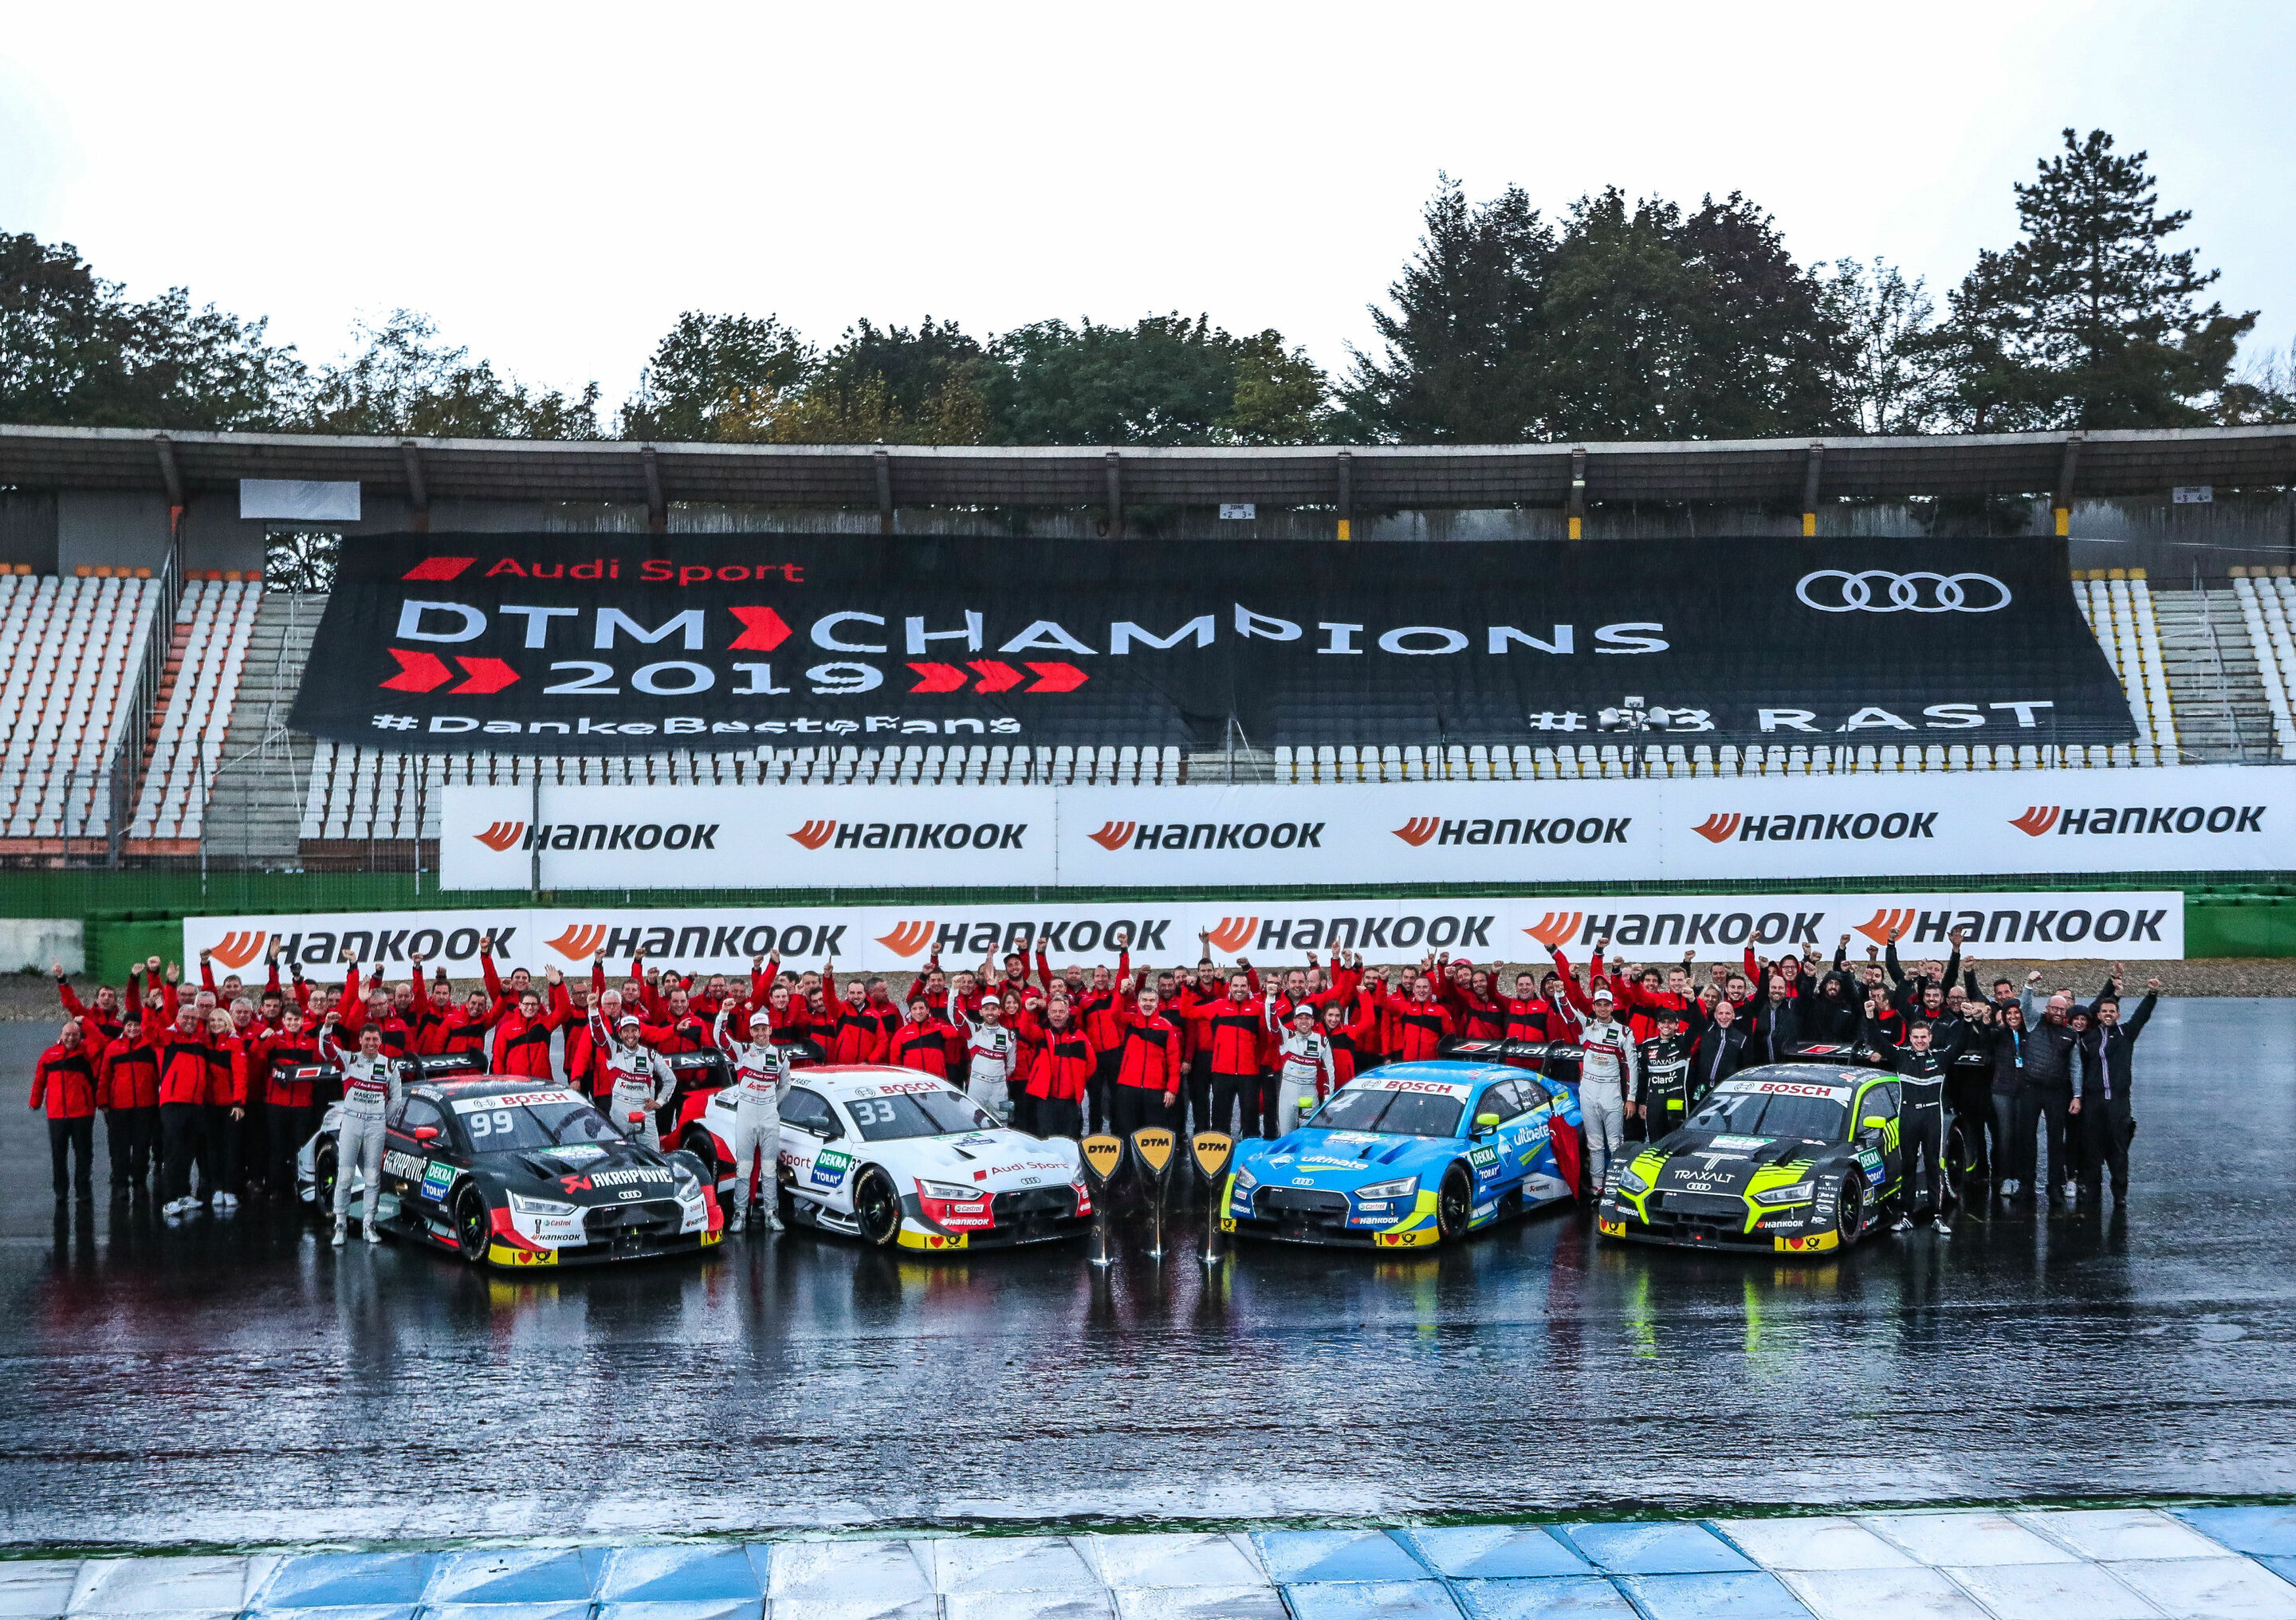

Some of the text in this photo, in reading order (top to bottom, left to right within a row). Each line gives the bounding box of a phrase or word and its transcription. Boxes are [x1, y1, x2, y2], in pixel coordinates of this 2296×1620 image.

[485, 558, 805, 586] Audi Sport
[395, 599, 1670, 655] DTM CHAMPIONS
[543, 661, 884, 695] 2019
[372, 714, 1021, 736] #DankeBesteFans
[1759, 702, 2054, 732] RAST
[1385, 1081, 1454, 1095] BOSCH
[1651, 1075, 1673, 1084] Claro
[879, 1082, 942, 1095] BOSCH
[1759, 1084, 1831, 1097] BOSCH
[501, 1092, 568, 1106] BOSCH
[1327, 1092, 1364, 1112] 4
[1696, 1095, 1751, 1116] 21
[855, 1100, 896, 1126] 33
[470, 1111, 514, 1138] 99
[1087, 1145, 1117, 1154] DTM
[1141, 1138, 1170, 1148] DTM
[1197, 1142, 1228, 1152] DTM
[819, 1152, 847, 1170] DEKRA
[1472, 1148, 1496, 1165] DEKRA
[428, 1164, 452, 1182] DEKRA
[992, 1162, 1069, 1175] Audi Sport
[1674, 1170, 1735, 1183] TRAXALT
